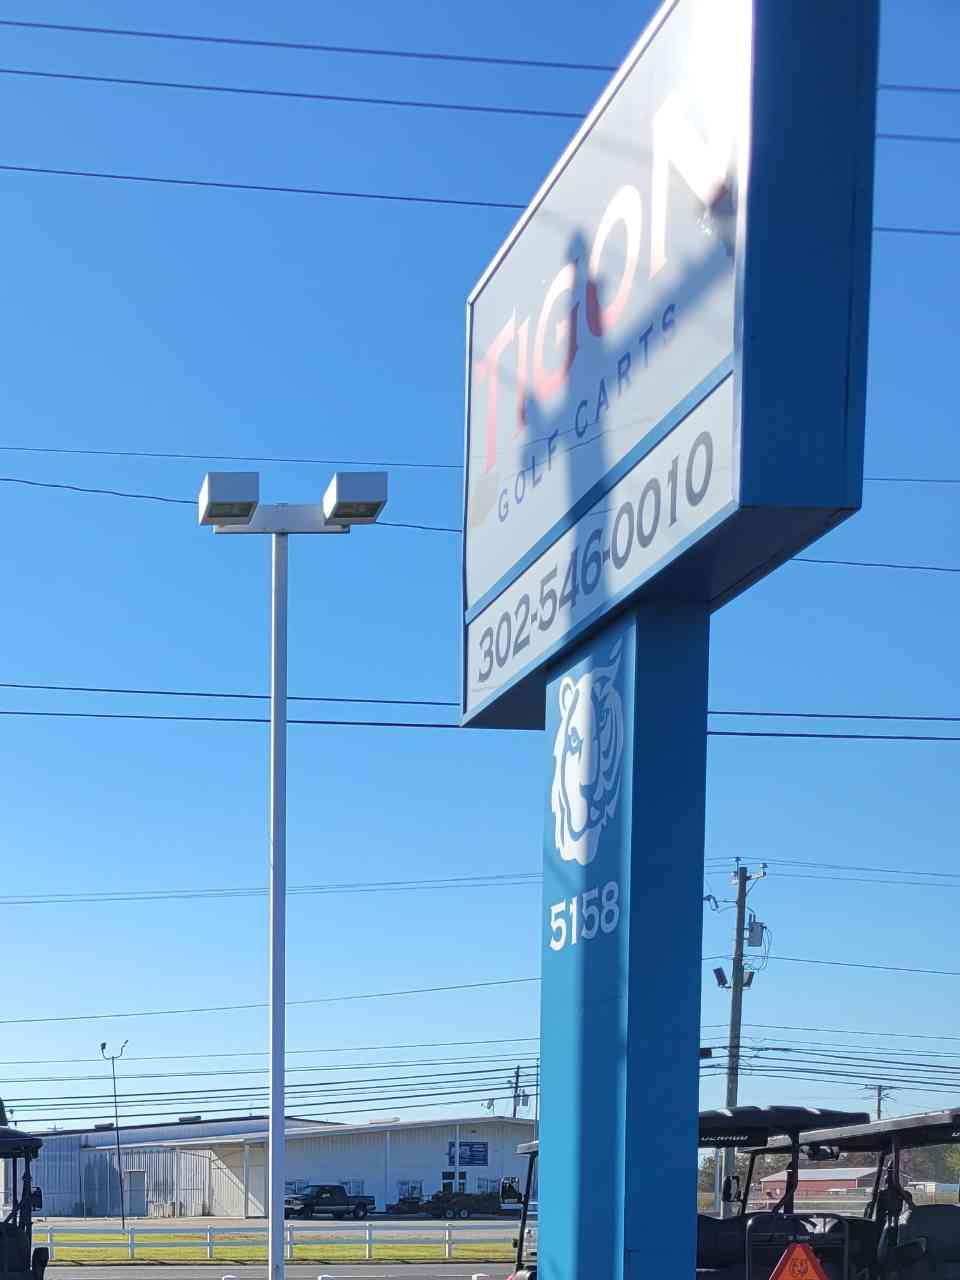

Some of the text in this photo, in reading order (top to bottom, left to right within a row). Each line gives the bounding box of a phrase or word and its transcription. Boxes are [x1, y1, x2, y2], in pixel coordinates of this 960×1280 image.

[474, 80, 738, 475] TIGON
[497, 301, 679, 523] GOLF CARTS
[477, 429, 715, 684] 302-546-0010
[549, 880, 620, 951] 5158
